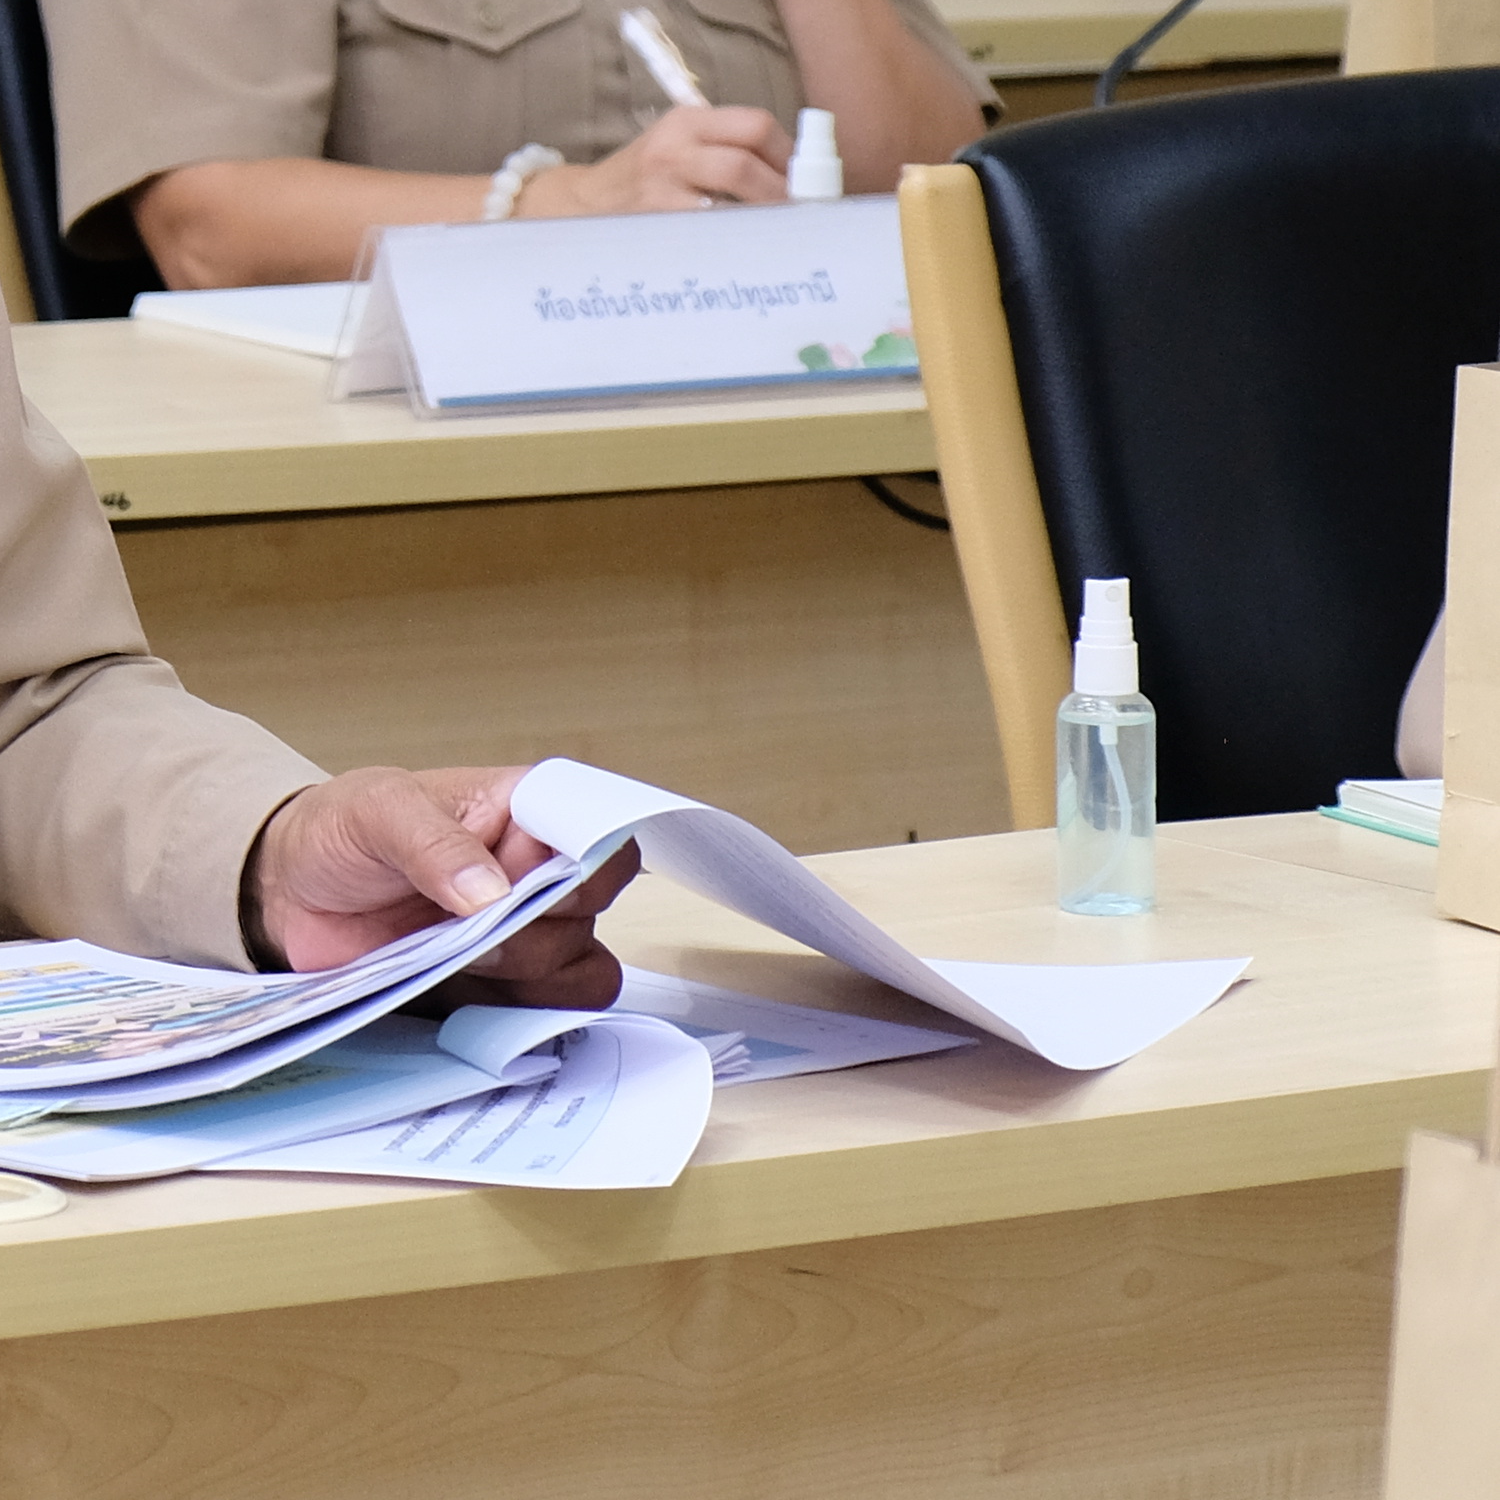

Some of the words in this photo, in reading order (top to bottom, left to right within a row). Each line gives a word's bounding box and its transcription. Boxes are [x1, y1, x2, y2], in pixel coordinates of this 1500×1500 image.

[533, 269, 838, 321] ท้องถิ่นจังหวัดปทุมธานี
